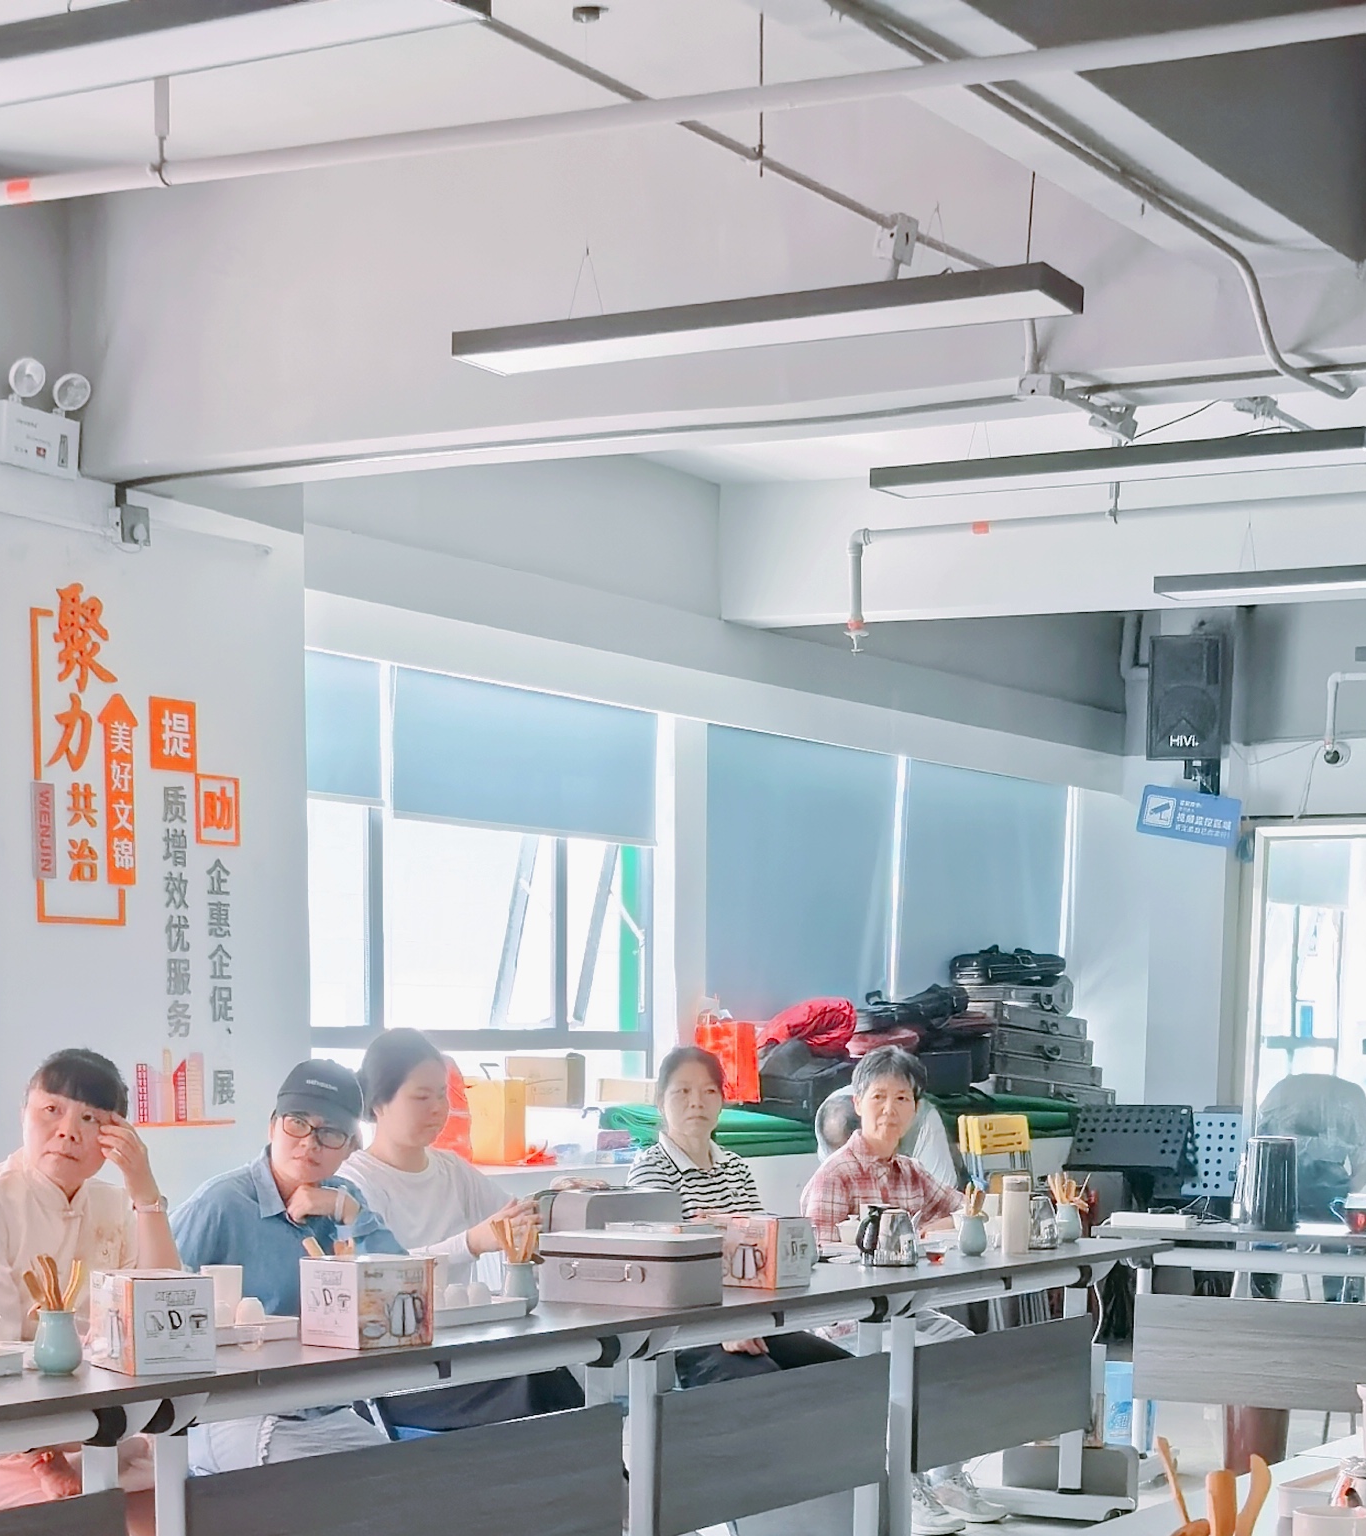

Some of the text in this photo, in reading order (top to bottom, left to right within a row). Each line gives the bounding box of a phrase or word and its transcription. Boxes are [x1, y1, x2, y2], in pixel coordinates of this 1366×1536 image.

[45, 582, 119, 883] 聚力共治
[110, 721, 135, 870] 美好文锦
[39, 789, 52, 873] WENJIN
